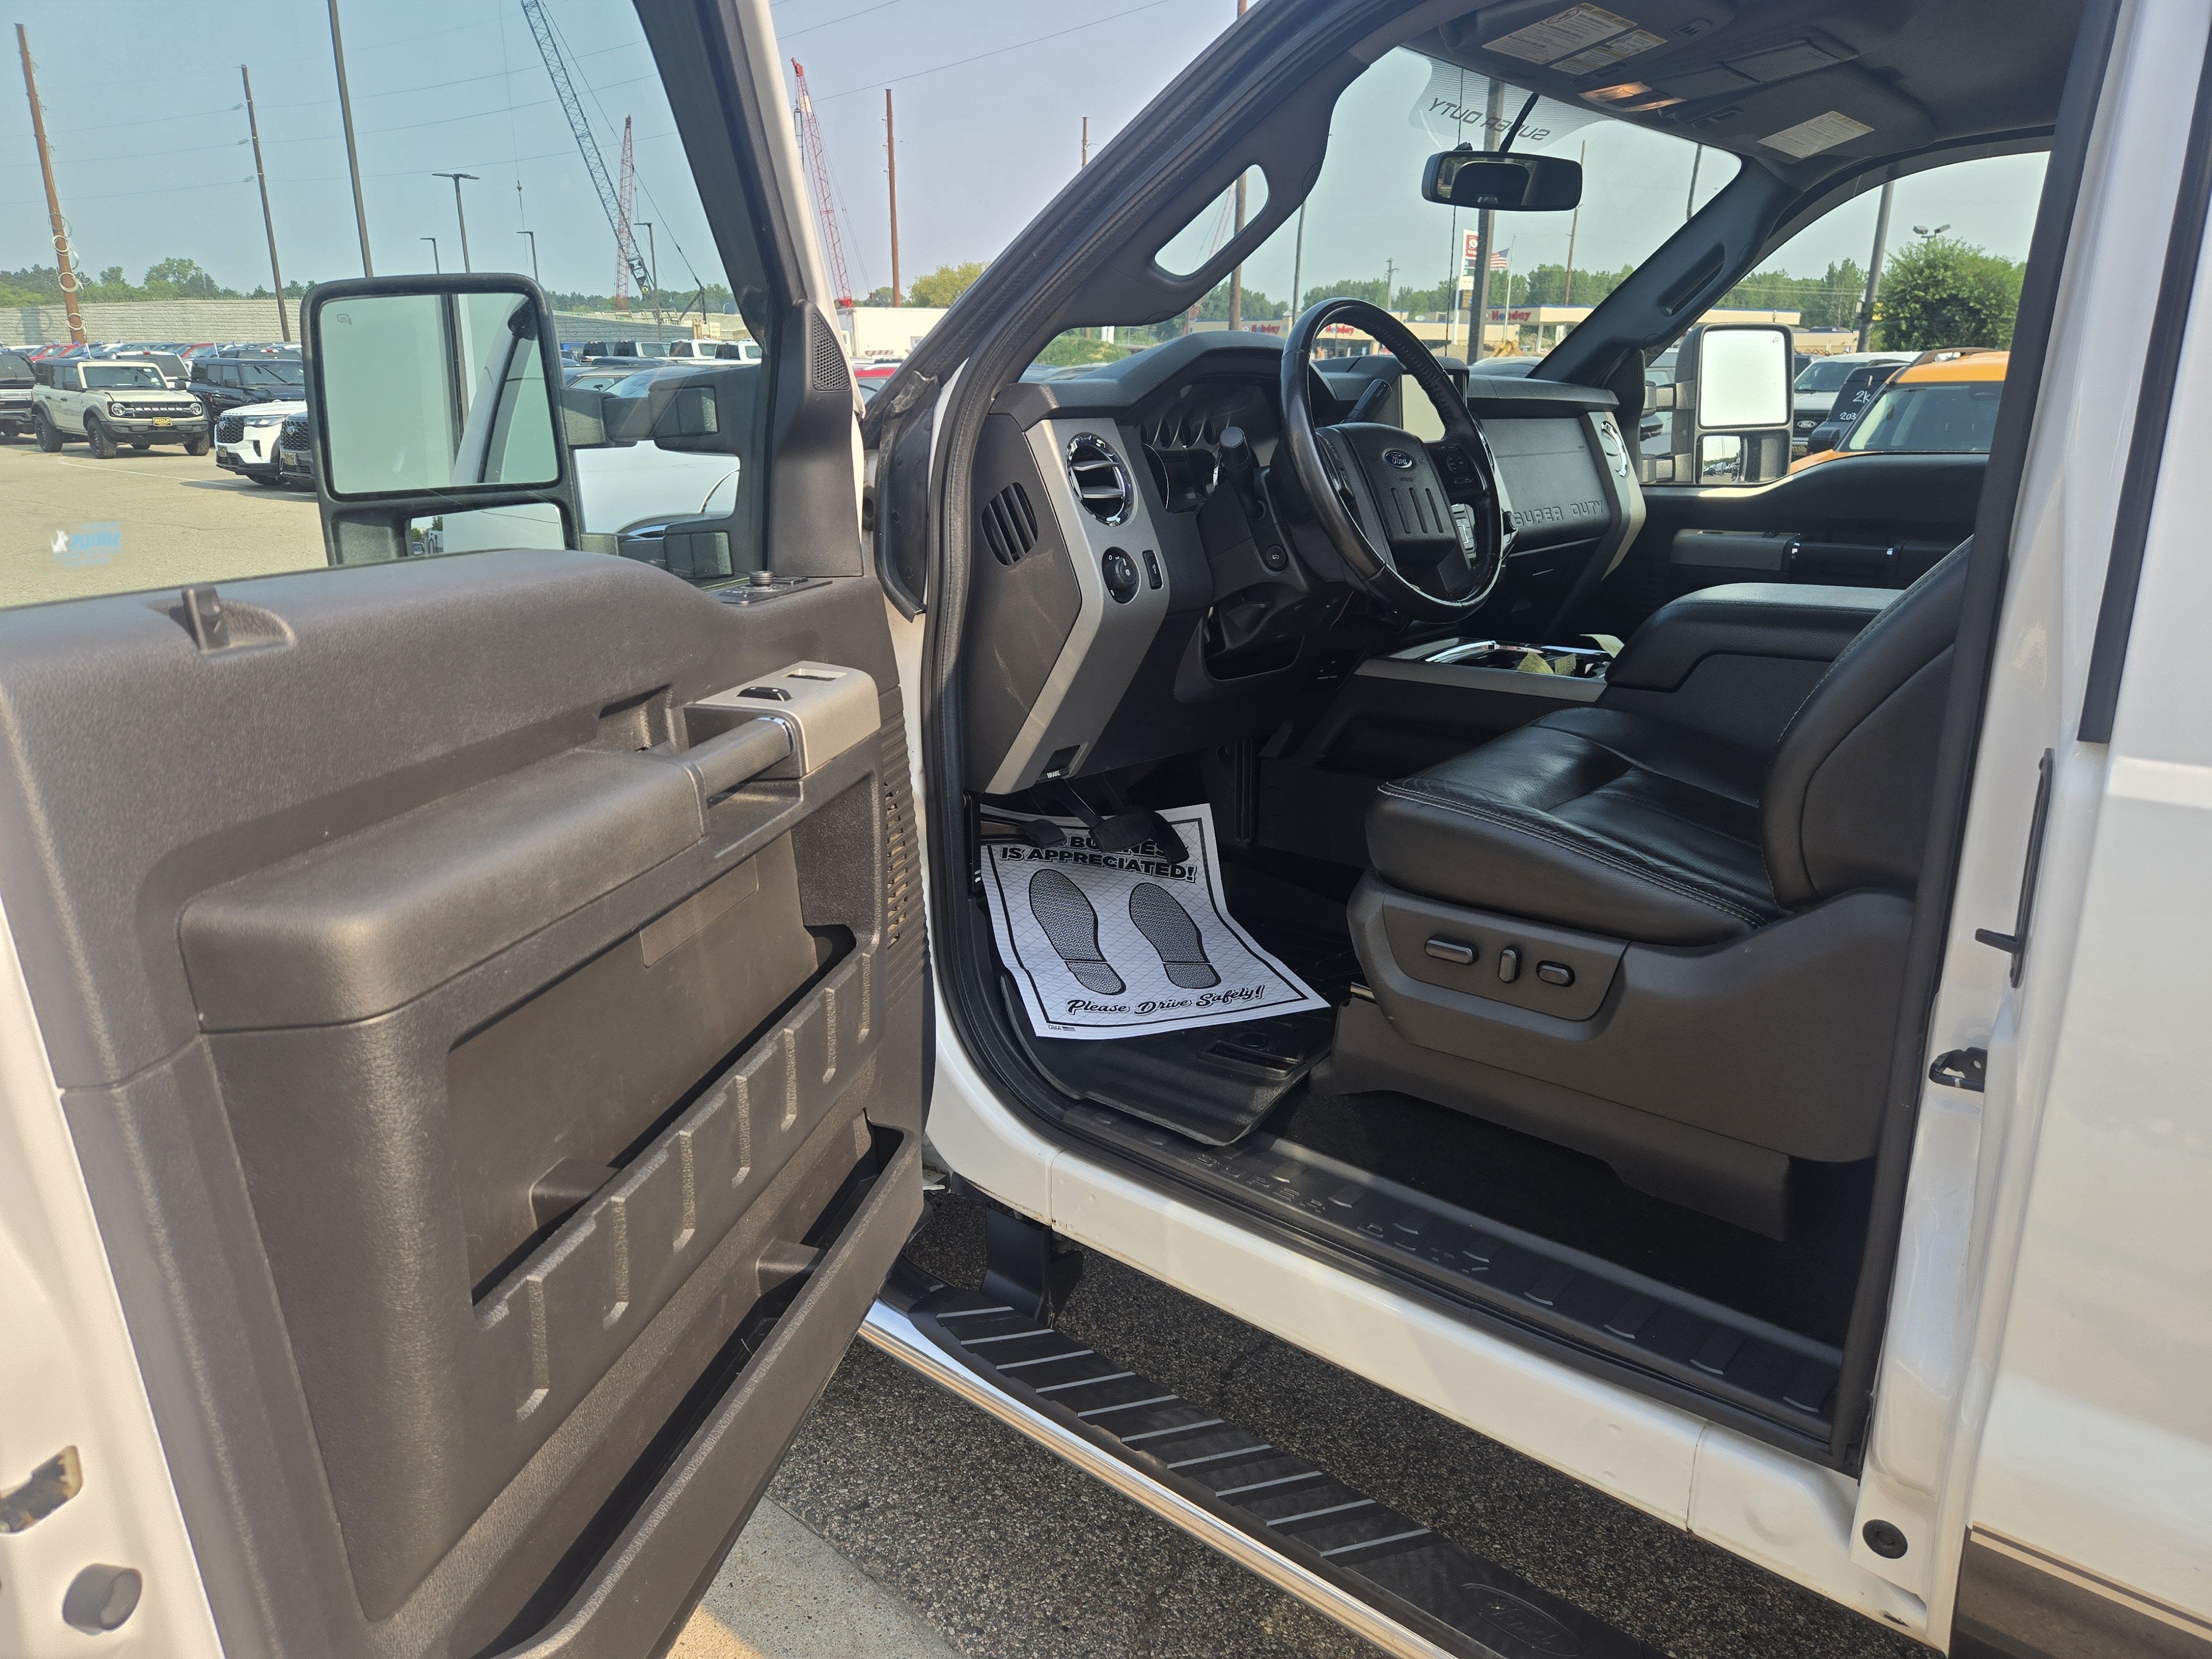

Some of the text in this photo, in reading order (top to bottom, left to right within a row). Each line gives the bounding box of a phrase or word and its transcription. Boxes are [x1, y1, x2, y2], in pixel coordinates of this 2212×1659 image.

[1491, 310, 1531, 321] Hoiday
[1513, 499, 1604, 526] SUPER DUTY
[1000, 847, 1197, 883] IS APPRECIATED!
[1066, 984, 1265, 1015] Please Drive Safely!
